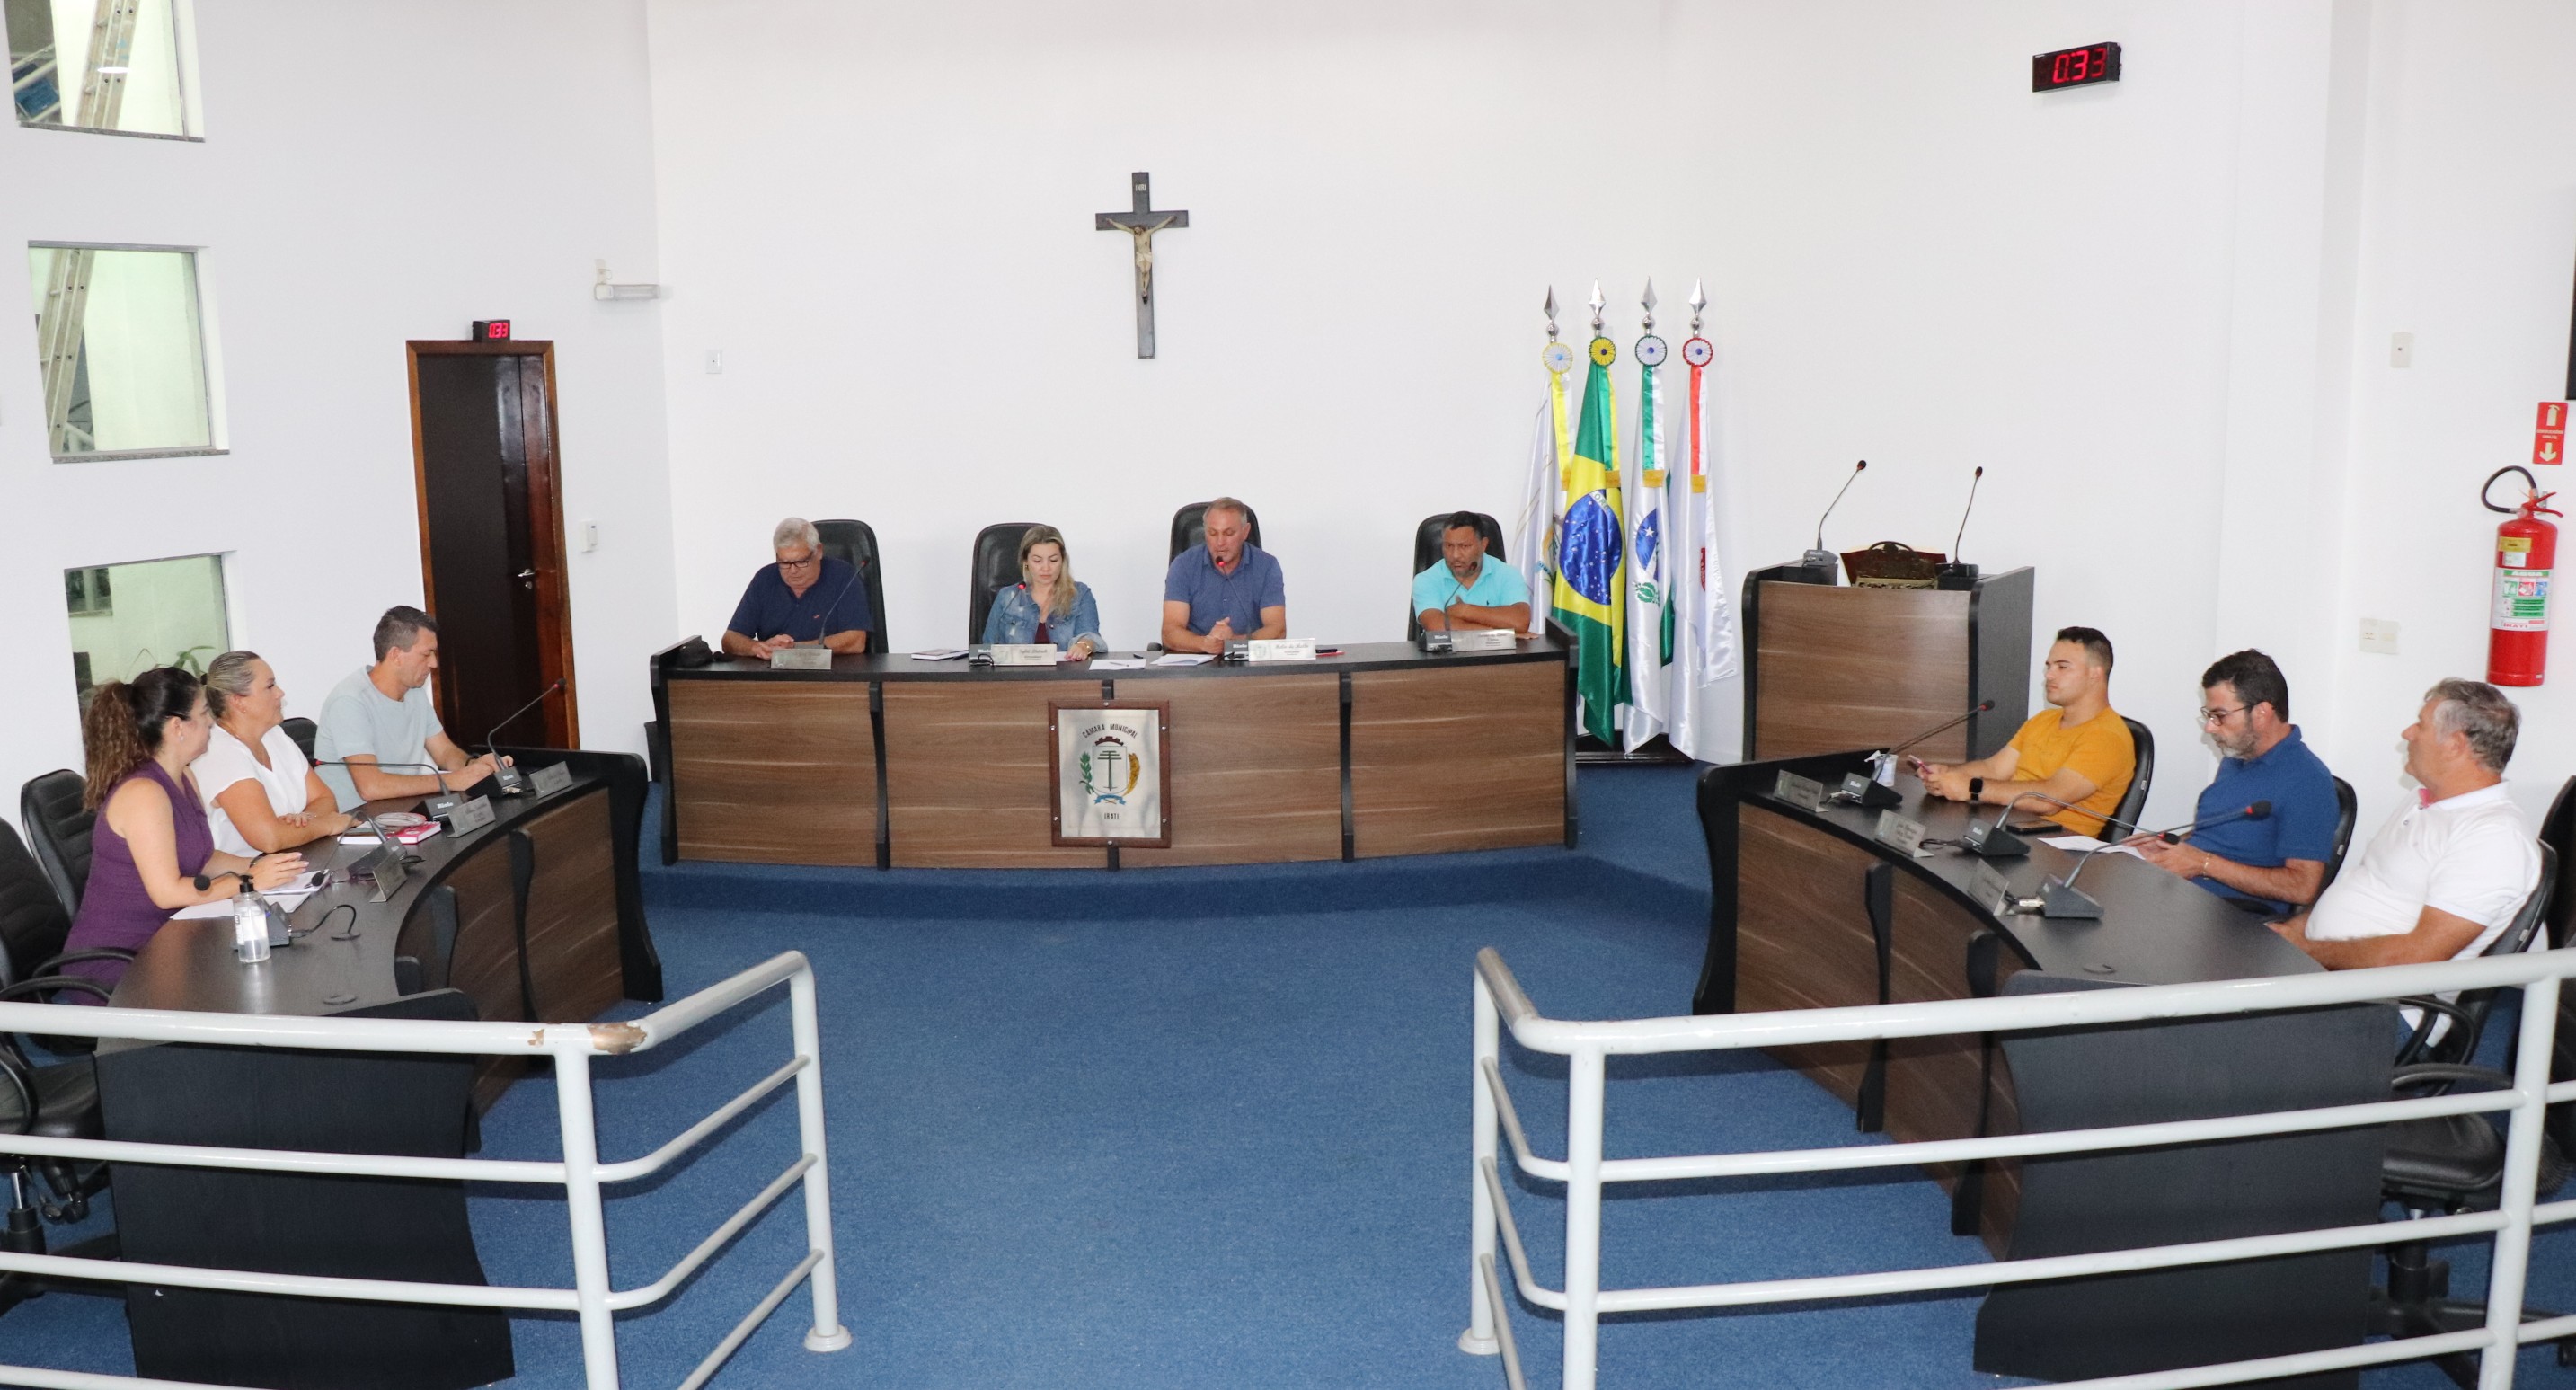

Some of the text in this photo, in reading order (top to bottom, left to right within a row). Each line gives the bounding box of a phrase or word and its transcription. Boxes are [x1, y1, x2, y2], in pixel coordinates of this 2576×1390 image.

[1135, 183, 1146, 191] INRI
[1110, 722, 1138, 739] MUNICIPAL
[1103, 812, 1120, 820] IRATI
